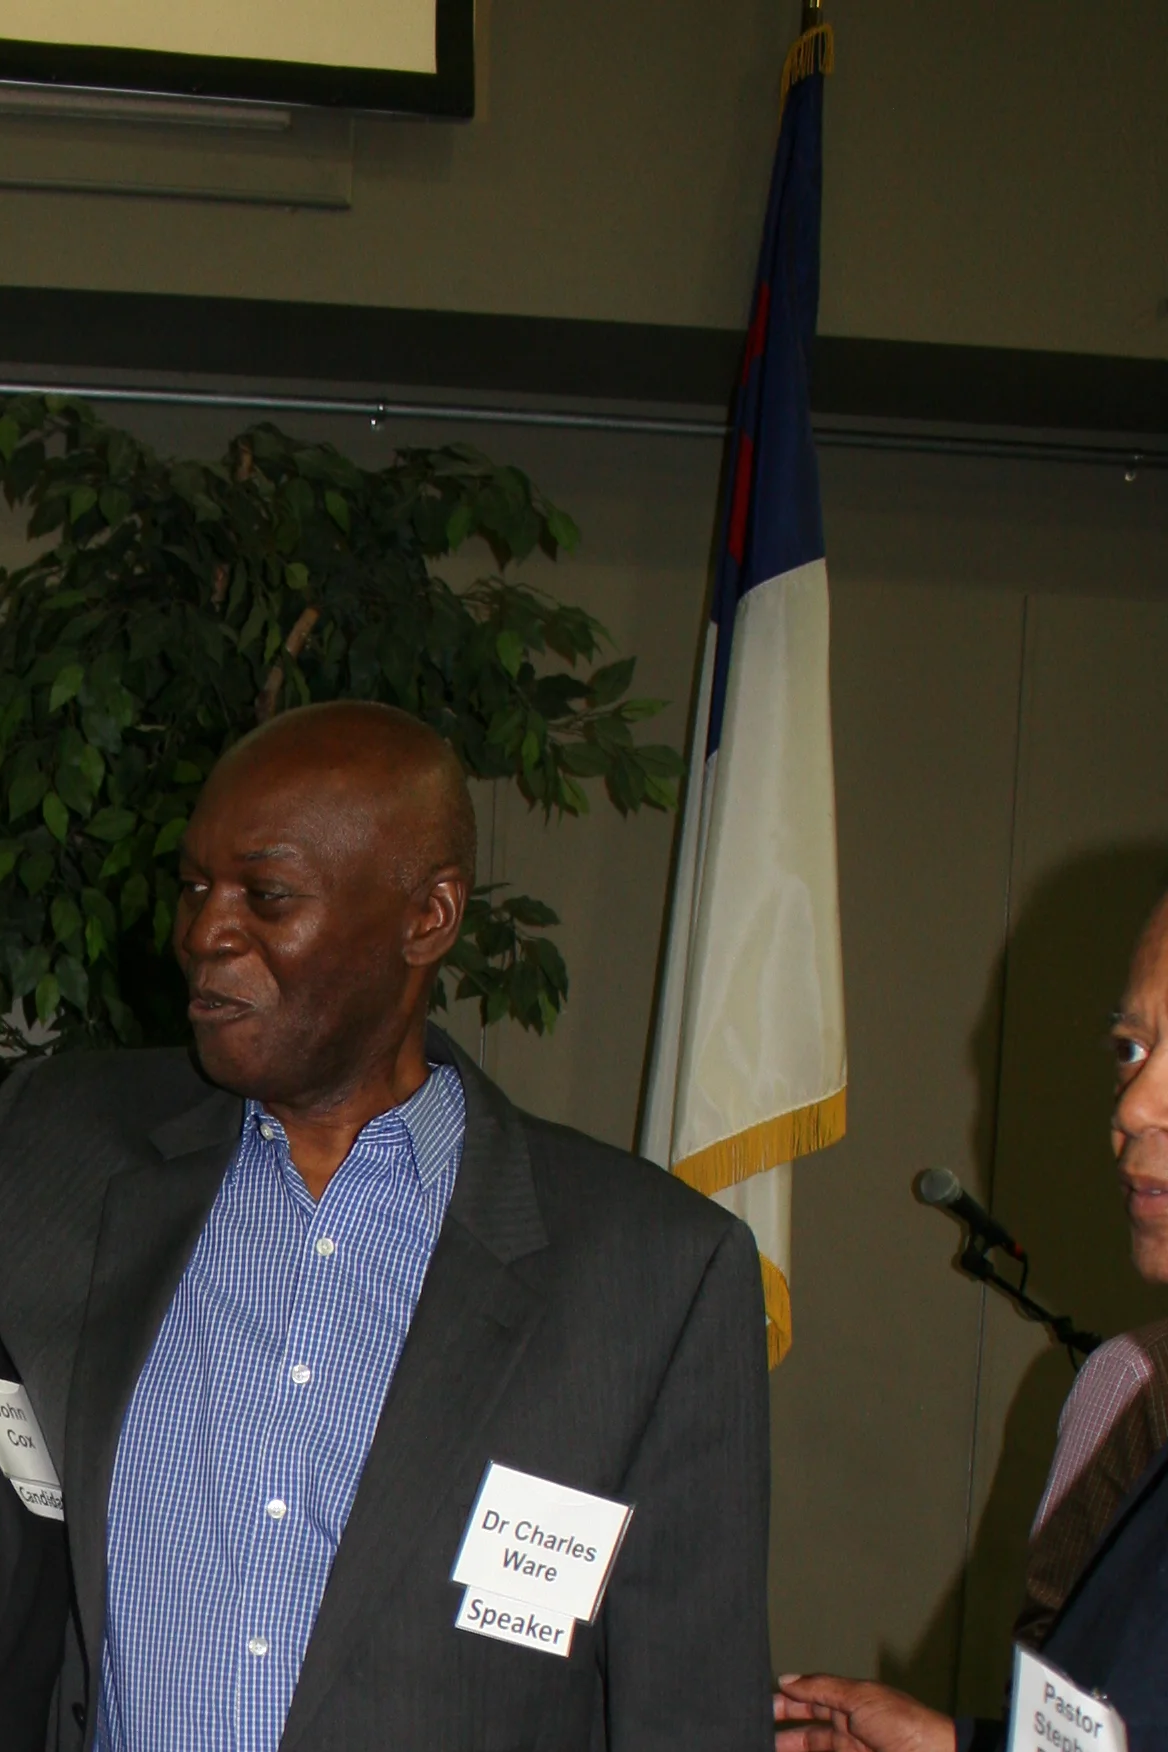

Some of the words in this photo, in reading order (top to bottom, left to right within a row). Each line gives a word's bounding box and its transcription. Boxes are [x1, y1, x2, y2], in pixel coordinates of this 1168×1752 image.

[7, 1428, 36, 1449] Cox
[482, 1510, 509, 1534] Dr
[514, 1520, 597, 1562] Charles
[502, 1548, 557, 1582] Ware
[467, 1598, 564, 1645] Speaker
[1043, 1682, 1103, 1739] Pastor
